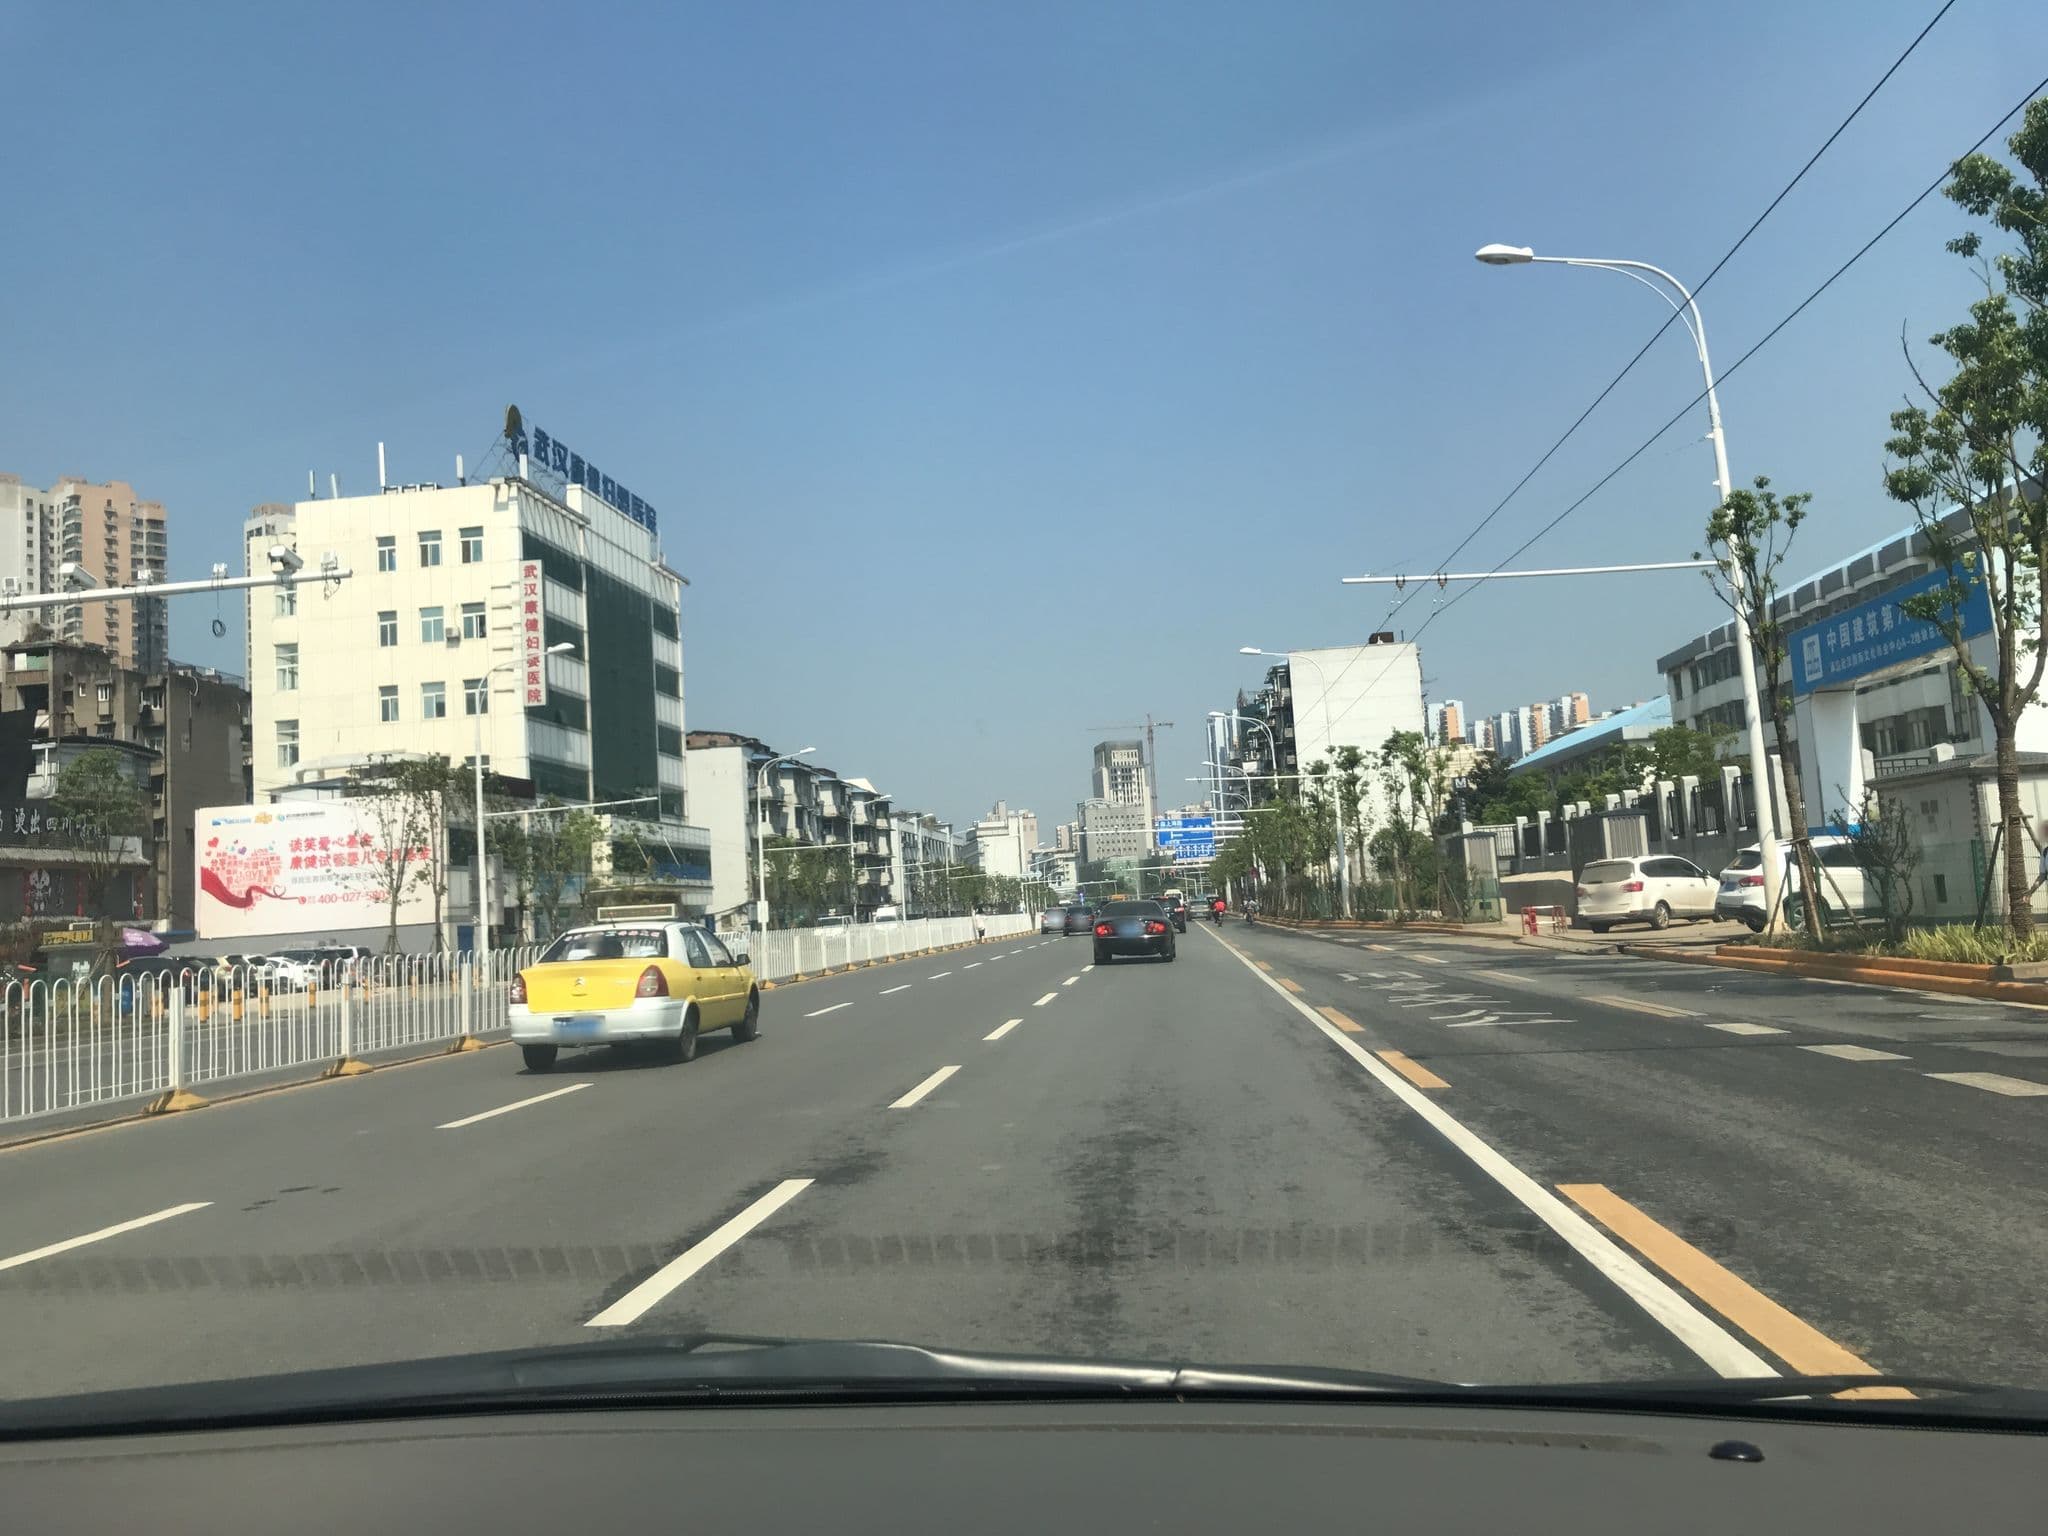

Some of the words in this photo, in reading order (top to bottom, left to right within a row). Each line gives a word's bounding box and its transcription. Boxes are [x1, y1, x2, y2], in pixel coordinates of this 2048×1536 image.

[523, 564, 542, 703] 武汉康健妇婴医院
